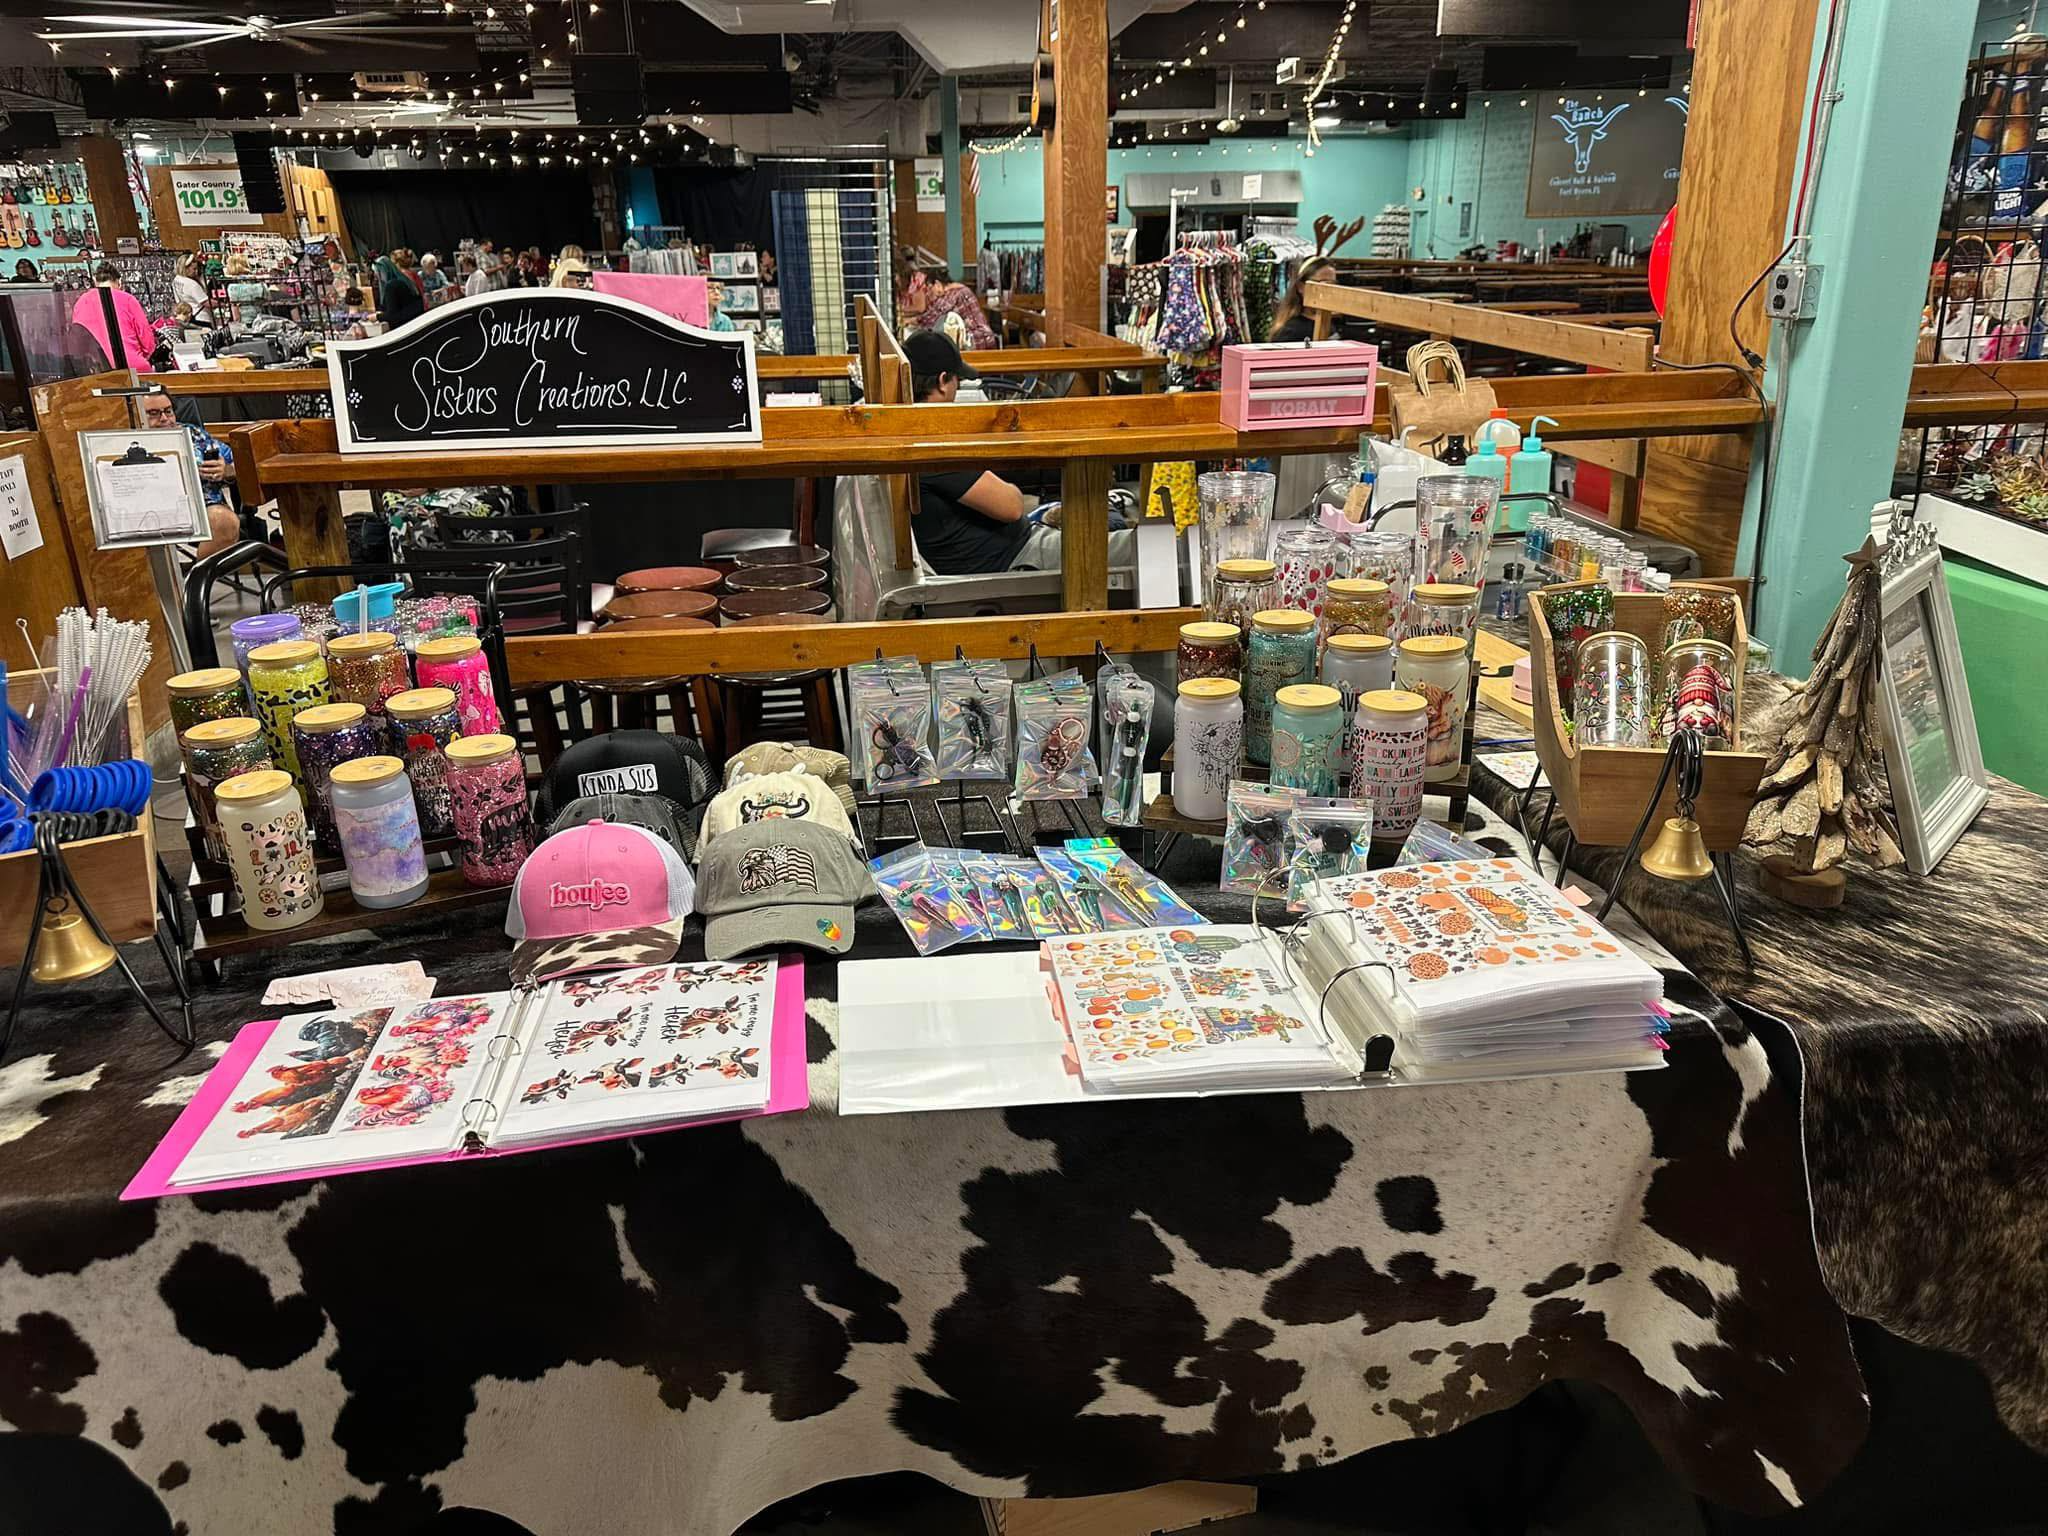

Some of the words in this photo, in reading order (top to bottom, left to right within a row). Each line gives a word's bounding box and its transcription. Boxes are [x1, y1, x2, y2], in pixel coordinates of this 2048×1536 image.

[1571, 107, 1604, 122] Ranch
[176, 181, 200, 189] Gator
[202, 180, 235, 189] Country
[178, 189, 239, 209] 101.9
[1994, 196, 2022, 211] LIGHT
[436, 307, 587, 373] Southern
[395, 357, 497, 432] Sisters
[1270, 399, 1338, 416] KOBALT
[0, 468, 14, 480] TAFF
[0, 482, 17, 493] ONLY
[8, 518, 30, 532] BOOTH
[1407, 623, 1454, 640] Merry
[579, 773, 625, 798] KINDA
[629, 767, 655, 790] SUS
[551, 878, 629, 909] boujee
[1406, 921, 1433, 941] SPICE
[659, 1005, 690, 1045] Heifer
[741, 1015, 757, 1038] crazy
[544, 1020, 581, 1060] Heifer
[628, 1025, 648, 1049] crazy
